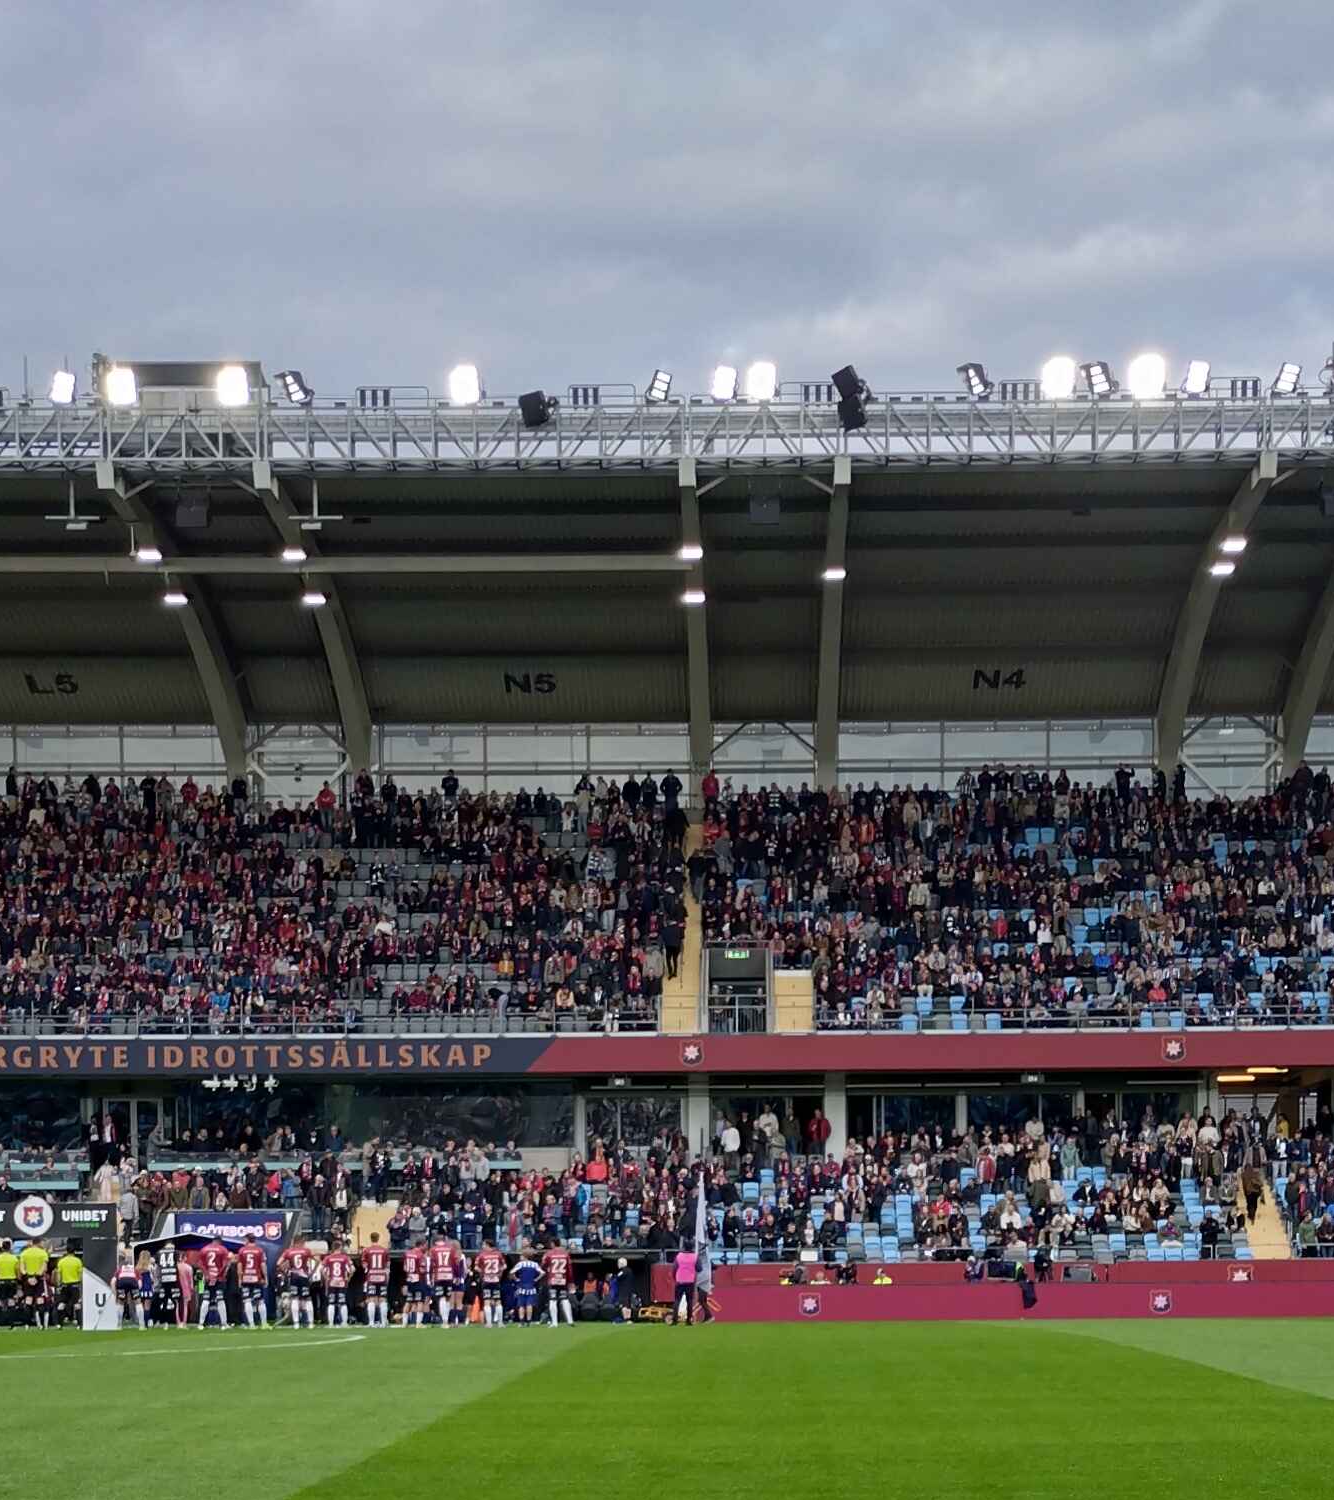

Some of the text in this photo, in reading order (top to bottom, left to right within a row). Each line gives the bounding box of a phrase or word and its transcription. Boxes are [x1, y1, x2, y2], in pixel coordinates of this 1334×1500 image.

[25, 674, 78, 694] L5
[504, 673, 556, 694] N5
[973, 669, 1026, 690] N4
[147, 1040, 492, 1069] IDROTTSSÄLLSKAP
[62, 1210, 108, 1222] UNIBET
[372, 1254, 383, 1269] 11
[437, 1251, 451, 1266] 17
